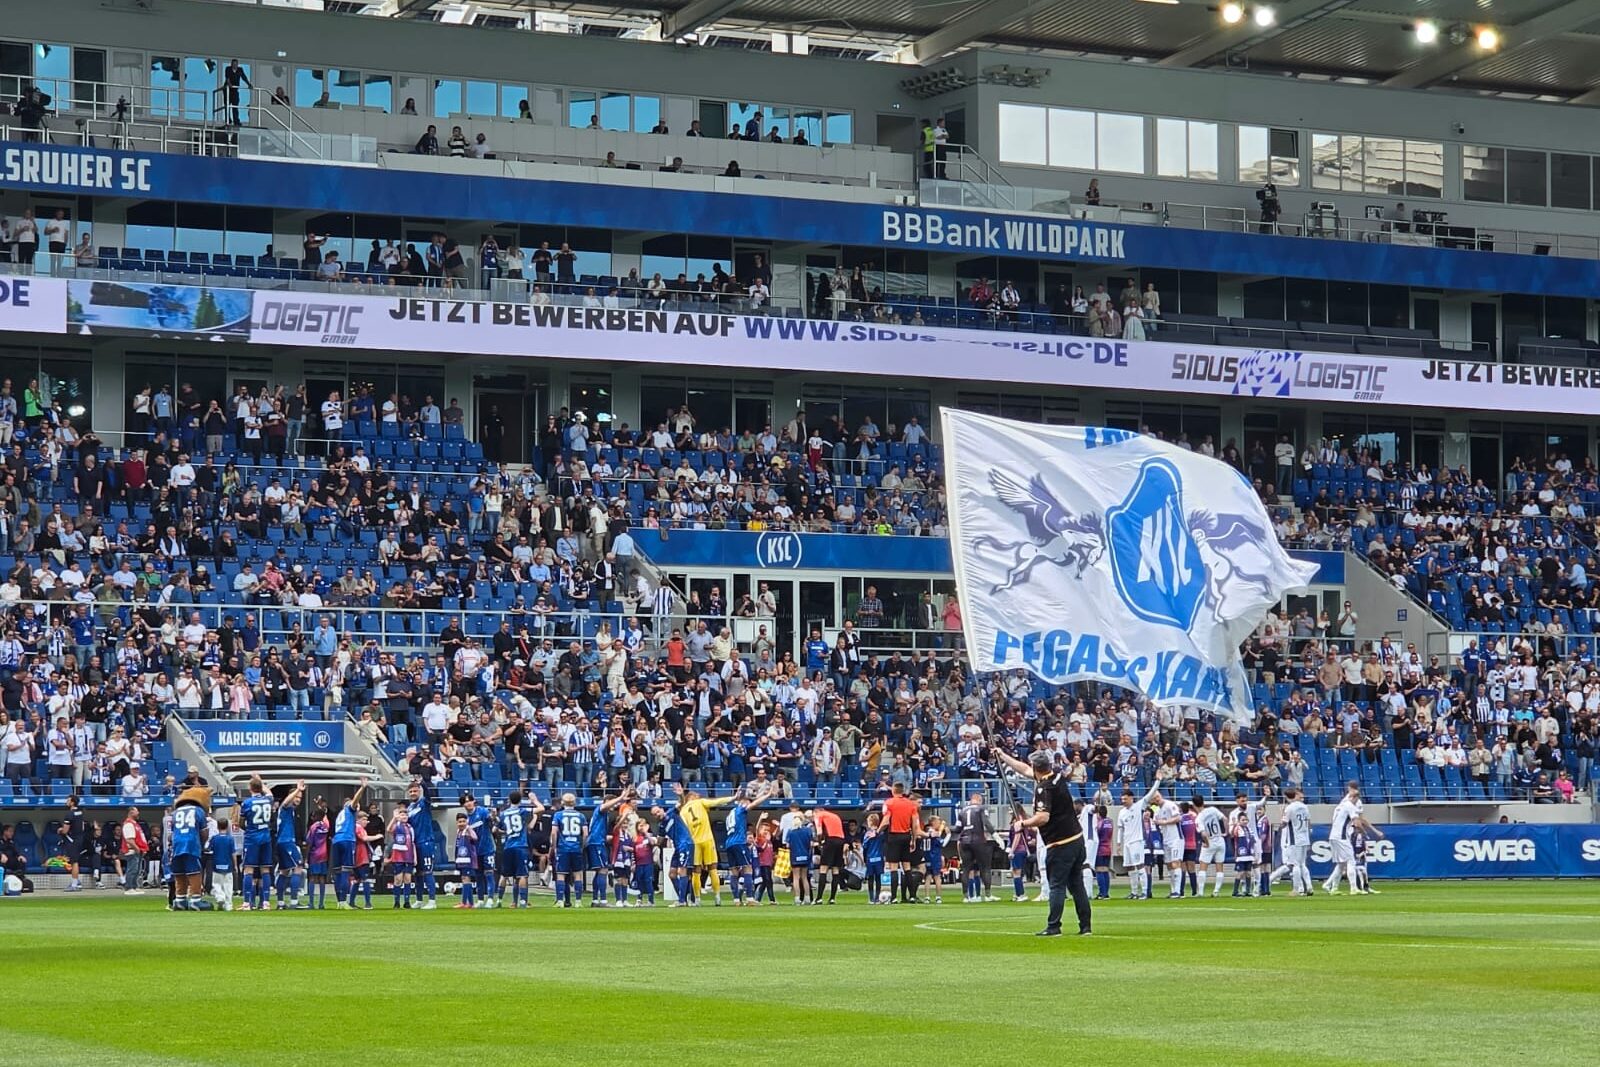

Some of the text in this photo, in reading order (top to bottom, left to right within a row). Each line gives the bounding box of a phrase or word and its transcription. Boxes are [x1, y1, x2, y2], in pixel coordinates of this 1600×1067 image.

[0, 148, 151, 191] SRUHER SC
[883, 211, 1125, 259] BBBank WILDPARK
[389, 298, 487, 324] JETZT
[492, 303, 667, 333] BEWERBEN
[673, 313, 737, 337] AUF
[1172, 353, 1388, 392] SIDUS LOGISTIC
[1422, 360, 1498, 383] JETZT
[767, 535, 792, 564] KSC
[218, 731, 287, 746] KARLSRUHER
[289, 732, 302, 746] SC
[175, 809, 196, 828] 94
[252, 803, 272, 824] 28
[504, 815, 522, 834] 19
[688, 807, 698, 821] 1
[966, 809, 972, 825] 1
[562, 817, 581, 836] 16
[1206, 821, 1218, 837] 16
[1310, 839, 1396, 863] SEG
[1453, 839, 1536, 862] SWEG
